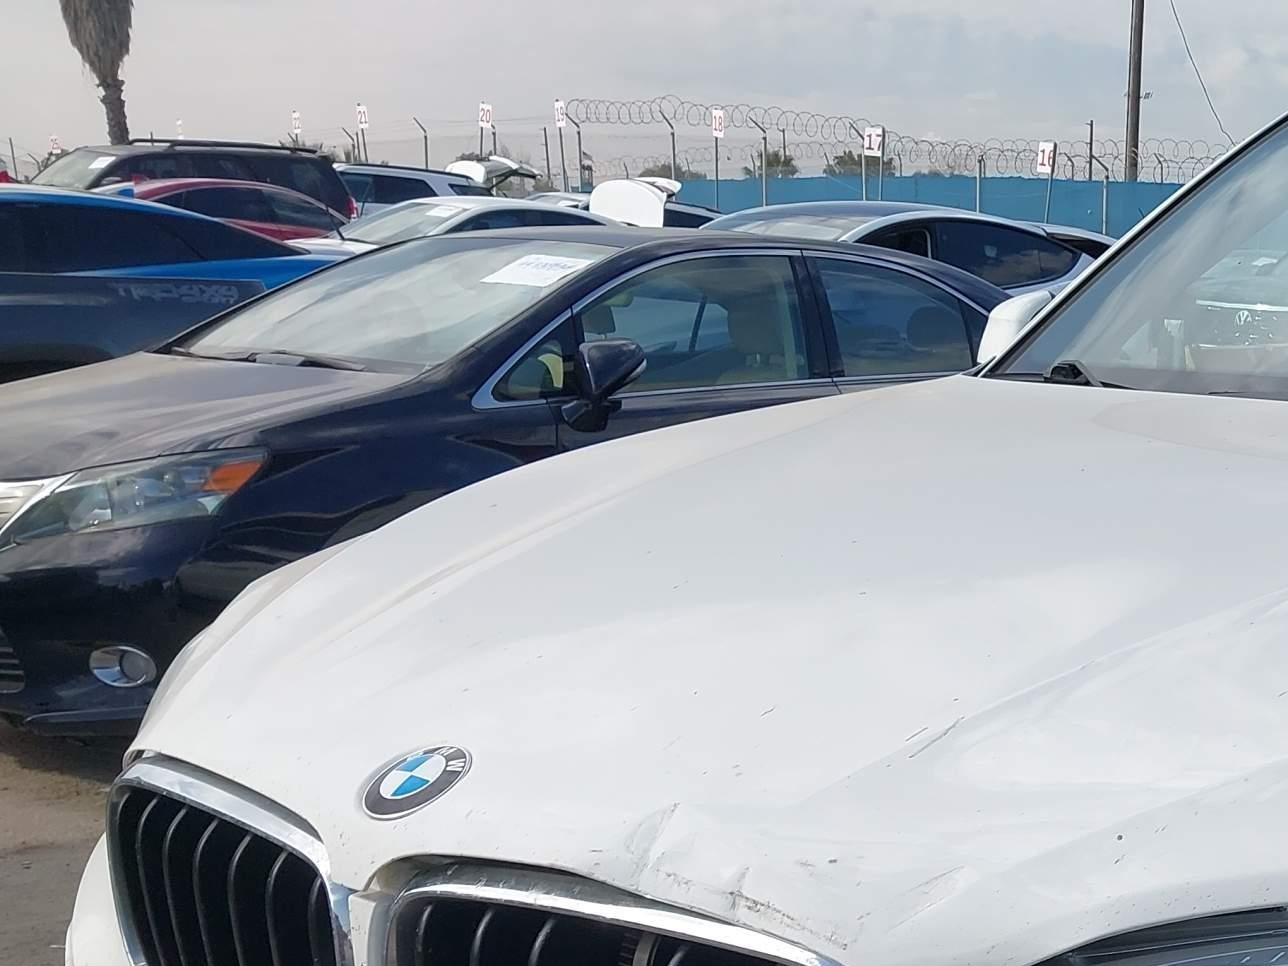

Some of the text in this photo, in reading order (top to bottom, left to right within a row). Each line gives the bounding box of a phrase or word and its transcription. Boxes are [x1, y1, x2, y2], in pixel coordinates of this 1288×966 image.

[480, 107, 491, 123] 20
[556, 106, 565, 122] 19
[713, 115, 723, 132] 18
[865, 133, 882, 151] 17
